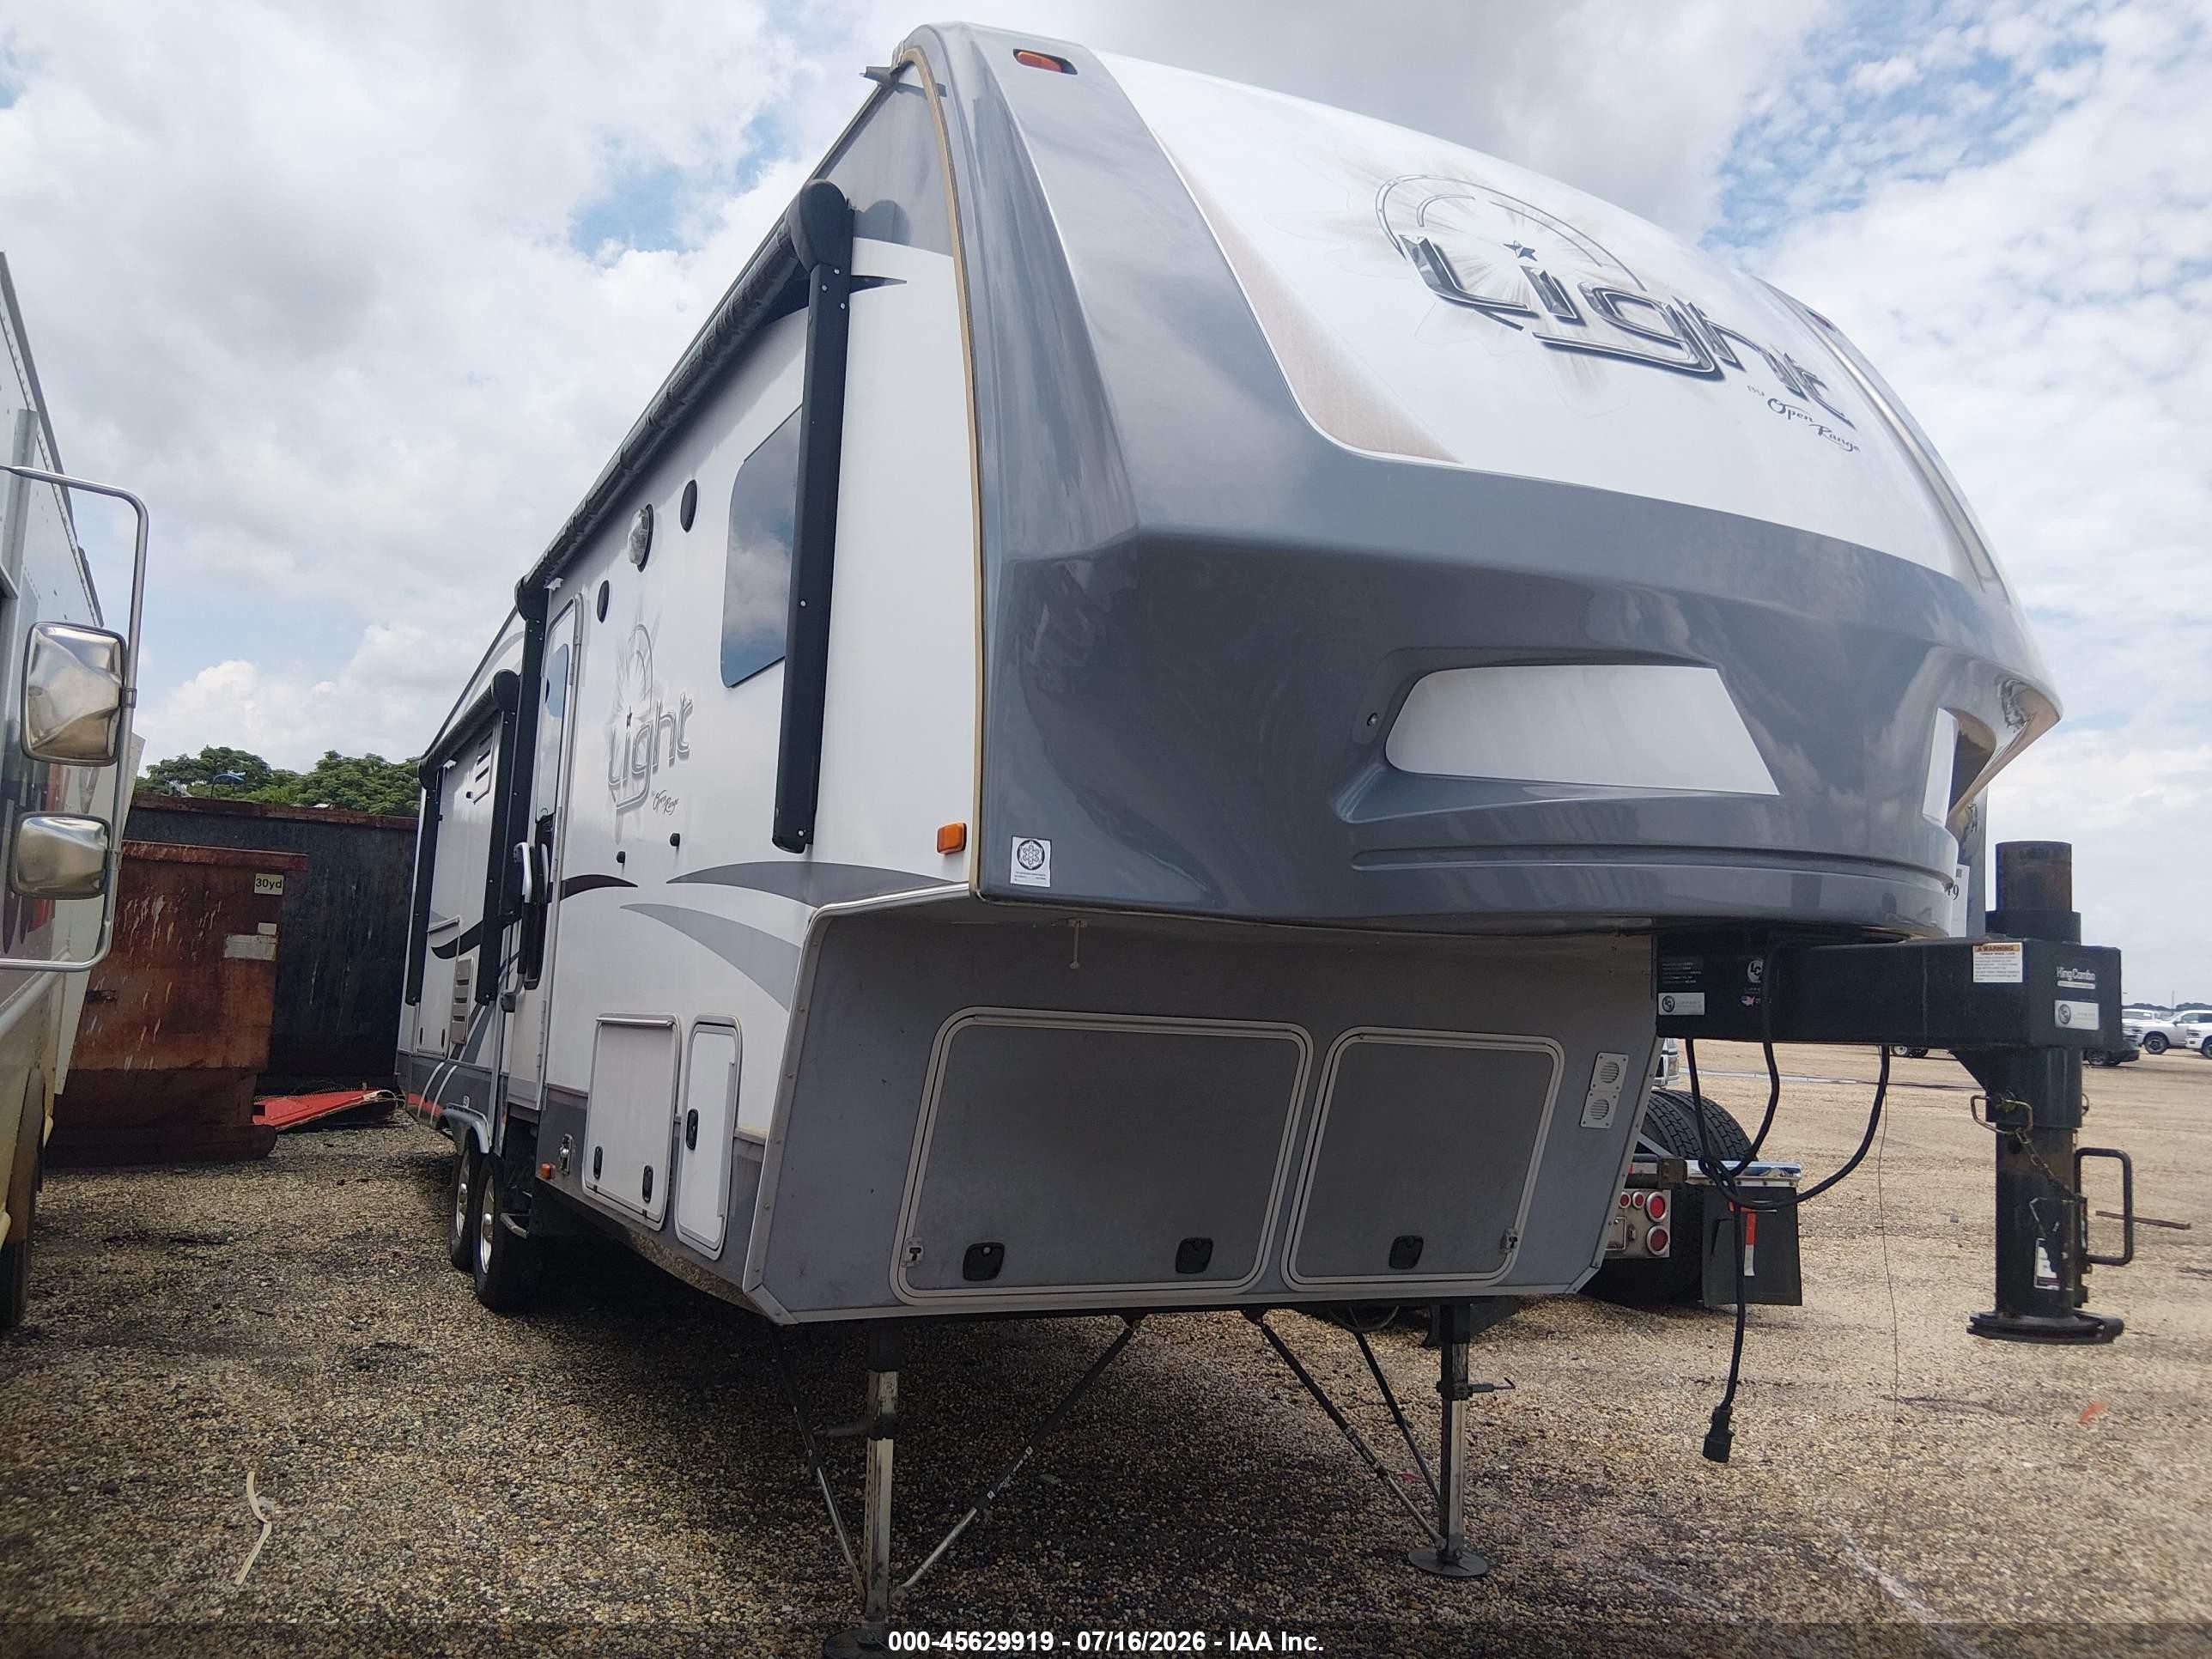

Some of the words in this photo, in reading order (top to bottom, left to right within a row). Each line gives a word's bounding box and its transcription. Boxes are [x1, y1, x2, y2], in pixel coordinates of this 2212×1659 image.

[1398, 234, 1856, 430] Light
[1767, 398, 1814, 422] Open
[1808, 423, 1860, 452] Range
[608, 693, 694, 815] Light
[256, 878, 283, 890] 30yd
